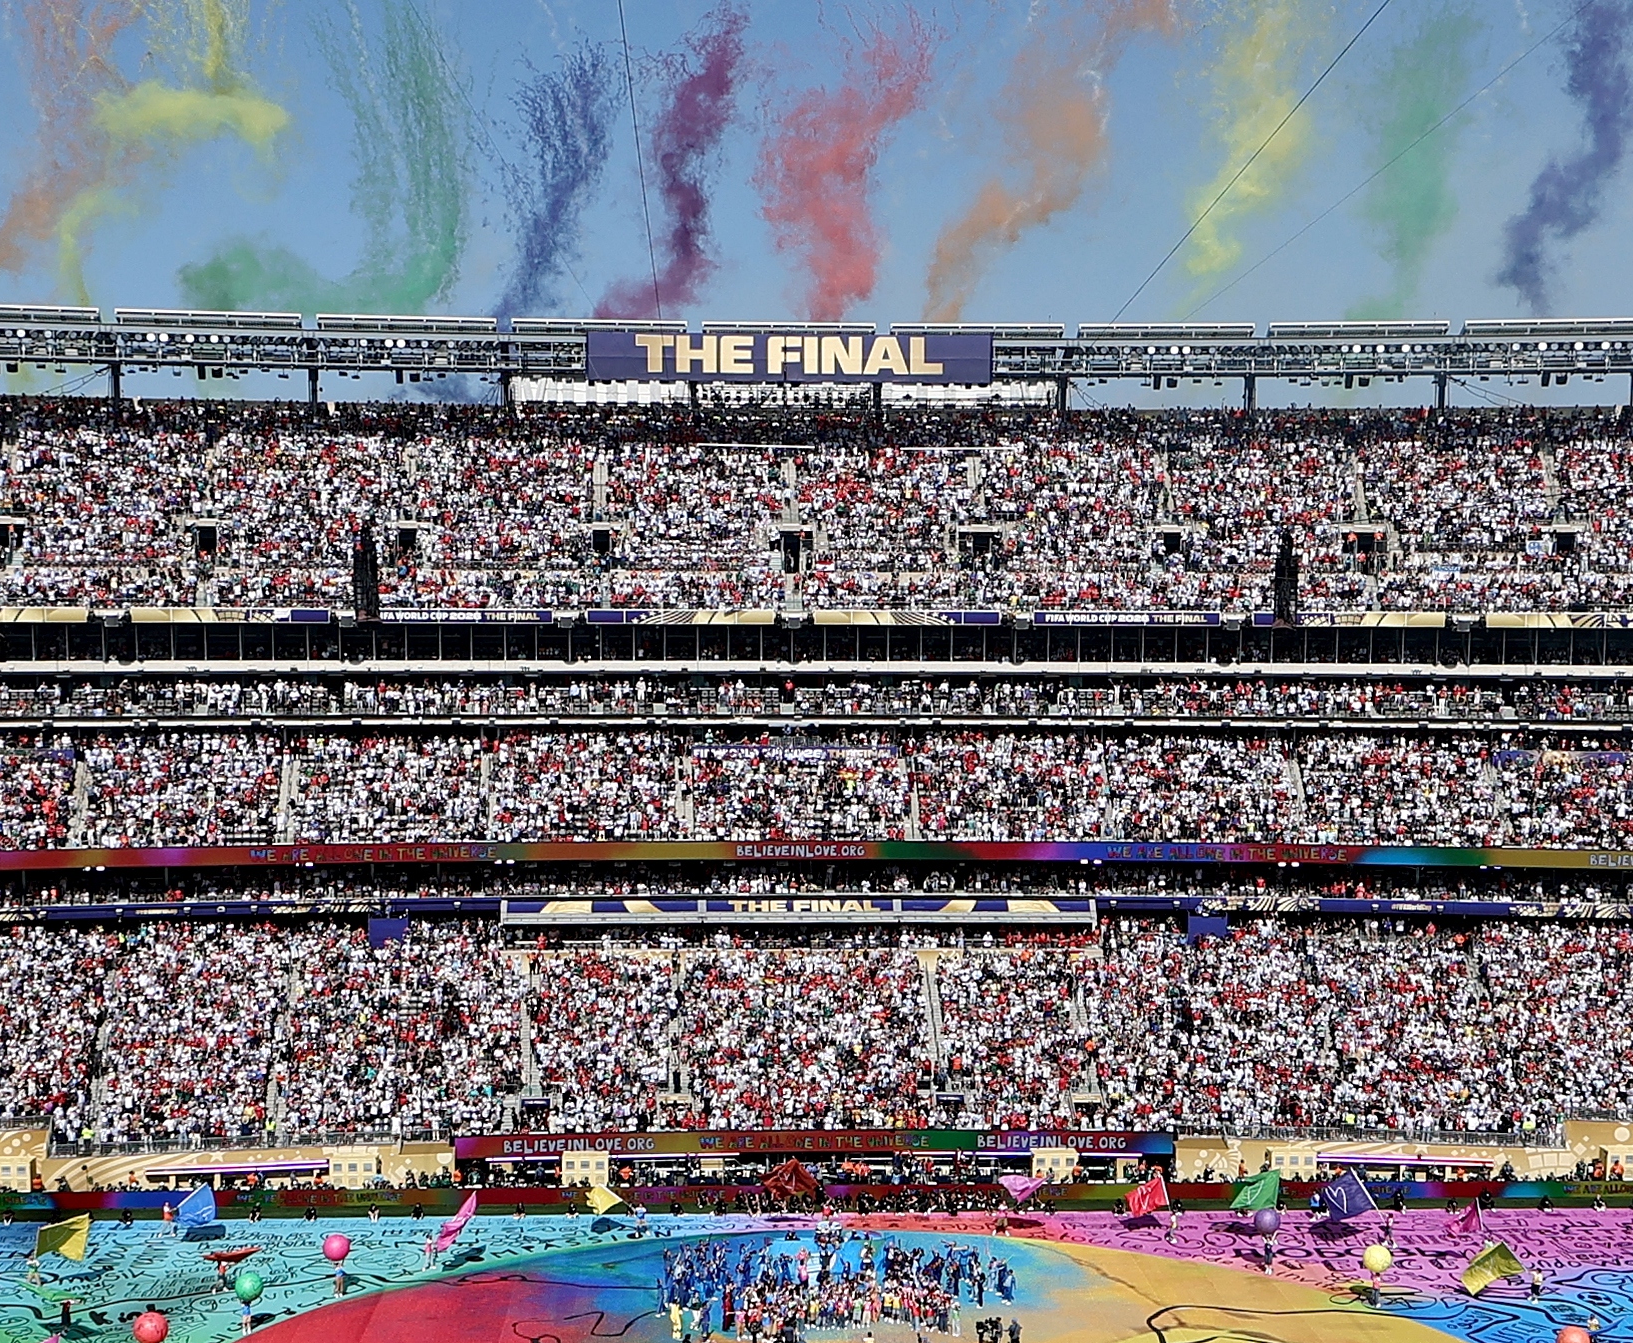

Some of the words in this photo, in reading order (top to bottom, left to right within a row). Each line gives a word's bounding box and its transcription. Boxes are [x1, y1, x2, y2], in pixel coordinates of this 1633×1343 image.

[635, 334, 754, 374] THE
[768, 335, 944, 376] FINAL
[395, 611, 429, 621] WORLD
[430, 611, 449, 621] CUP
[449, 611, 482, 620] 2026
[484, 611, 506, 621] THE
[508, 611, 540, 621] FINAL
[1045, 613, 1064, 623] FIFA
[1066, 613, 1098, 623] WORLD
[1099, 613, 1117, 623] CUP
[1118, 613, 1150, 623] 2026
[1152, 613, 1174, 623] THE
[1175, 613, 1207, 623] FINAL
[249, 849, 277, 862] WE
[736, 845, 866, 858] BELIEVEINLOVE.ORG
[1107, 846, 1132, 859] WE
[728, 900, 788, 912] THE
[792, 900, 881, 912] FINAL
[502, 1137, 656, 1154] BELIEVEINLOVE.ORG
[698, 1136, 725, 1149] WE
[976, 1134, 1127, 1150] BELIEVEINLOVE.ORG
